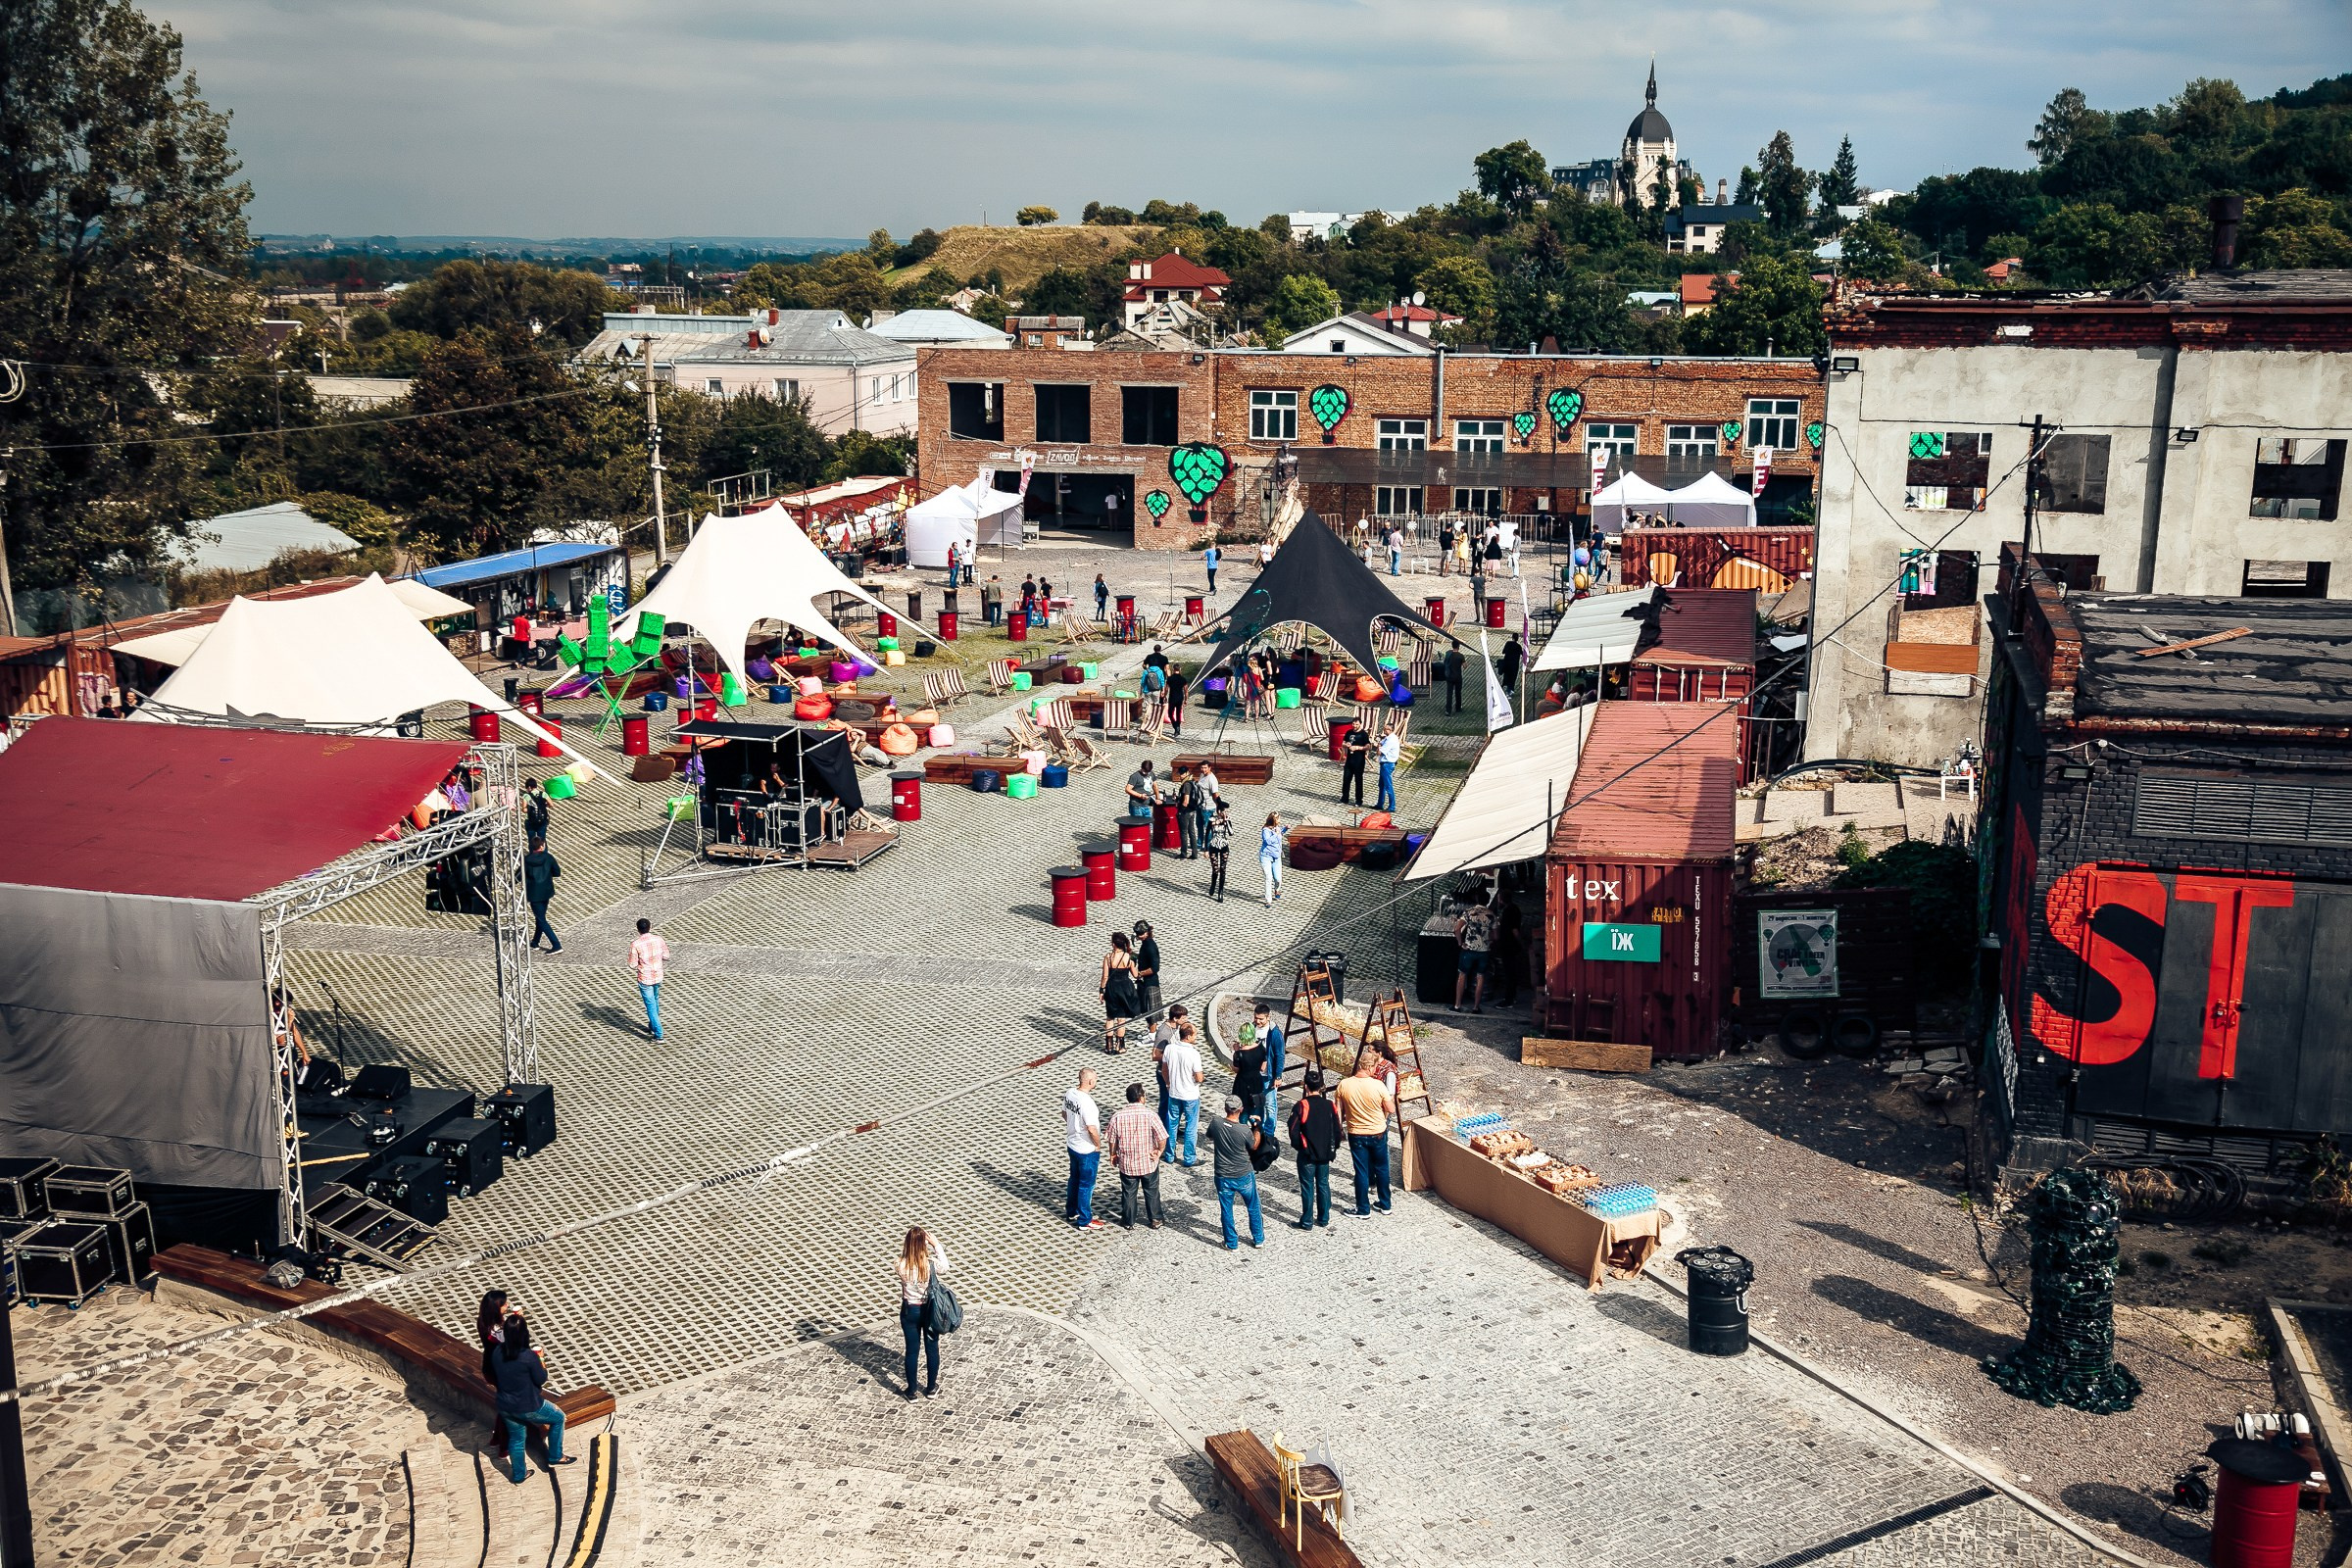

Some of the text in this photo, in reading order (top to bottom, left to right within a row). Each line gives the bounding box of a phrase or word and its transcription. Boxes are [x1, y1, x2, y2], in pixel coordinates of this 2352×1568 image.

[1565, 873, 1620, 901] tex
[1610, 928, 1635, 952] ЇЖ
[1777, 948, 1808, 960] CRAFT
[1693, 971, 1699, 981] 3
